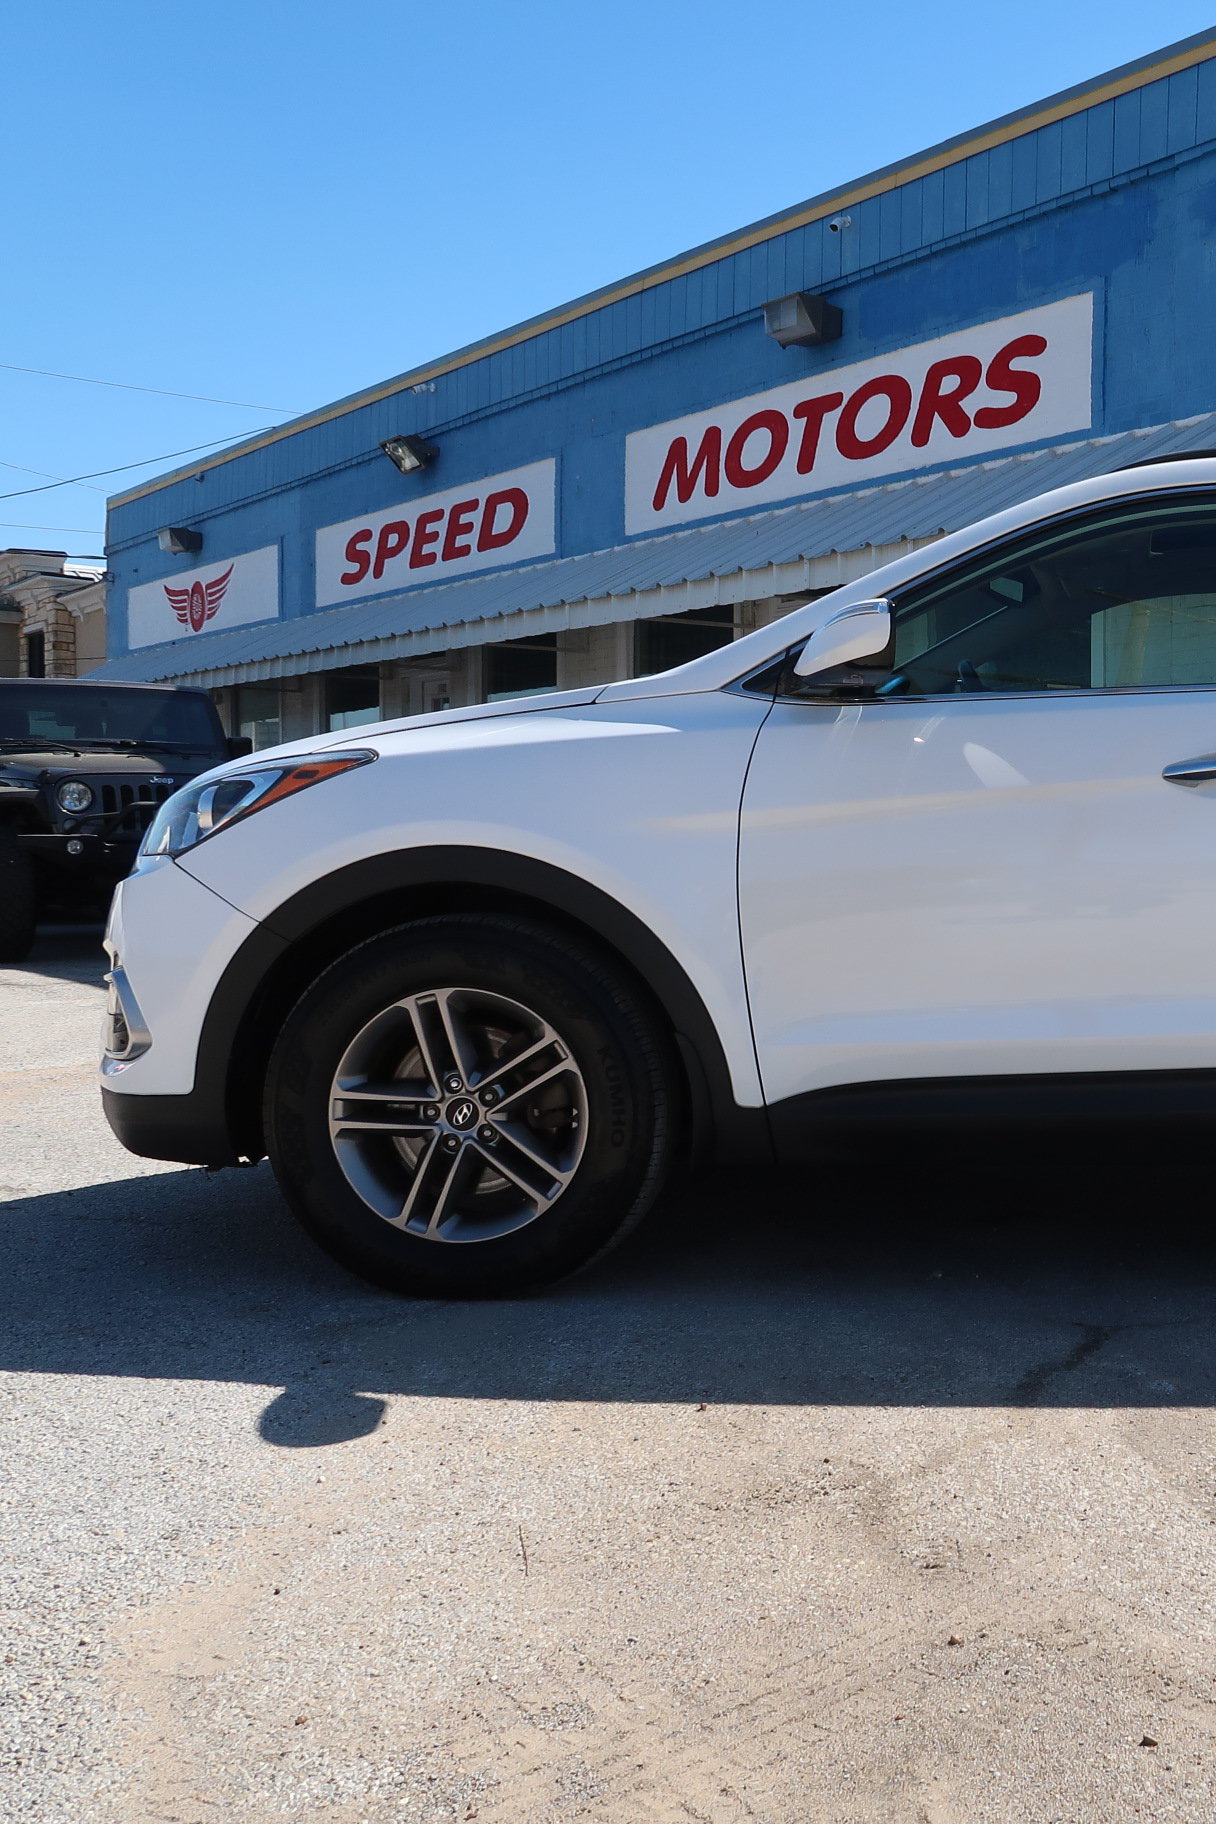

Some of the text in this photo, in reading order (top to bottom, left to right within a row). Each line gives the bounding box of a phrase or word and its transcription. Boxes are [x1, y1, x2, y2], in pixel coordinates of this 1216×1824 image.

[342, 334, 1046, 586] SPEED MOTORS
[149, 775, 174, 785] Jeep
[597, 1045, 625, 1148] KUMHO
